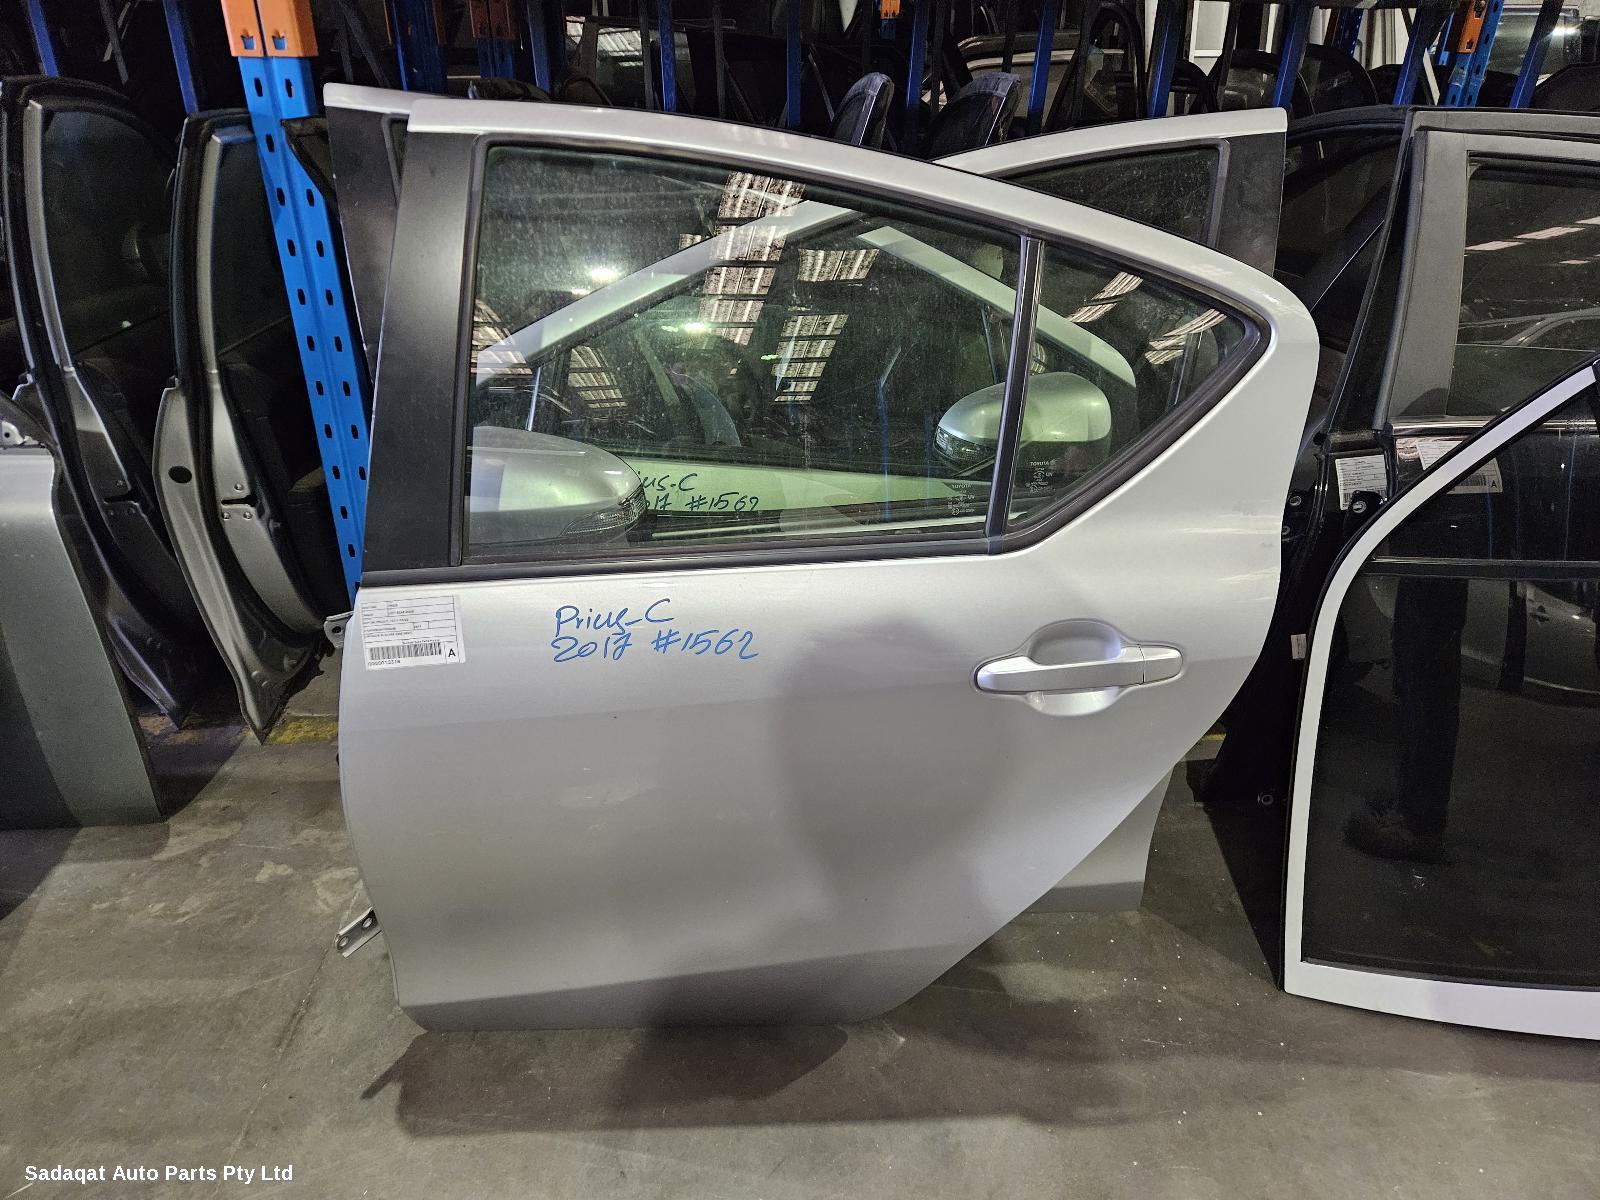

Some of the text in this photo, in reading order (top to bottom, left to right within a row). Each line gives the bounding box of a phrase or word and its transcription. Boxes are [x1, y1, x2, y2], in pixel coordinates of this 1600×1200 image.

[637, 471, 698, 492] us-C
[1491, 480, 1497, 488] A
[448, 648, 456, 657] A
[551, 628, 759, 663] 2017 #1562
